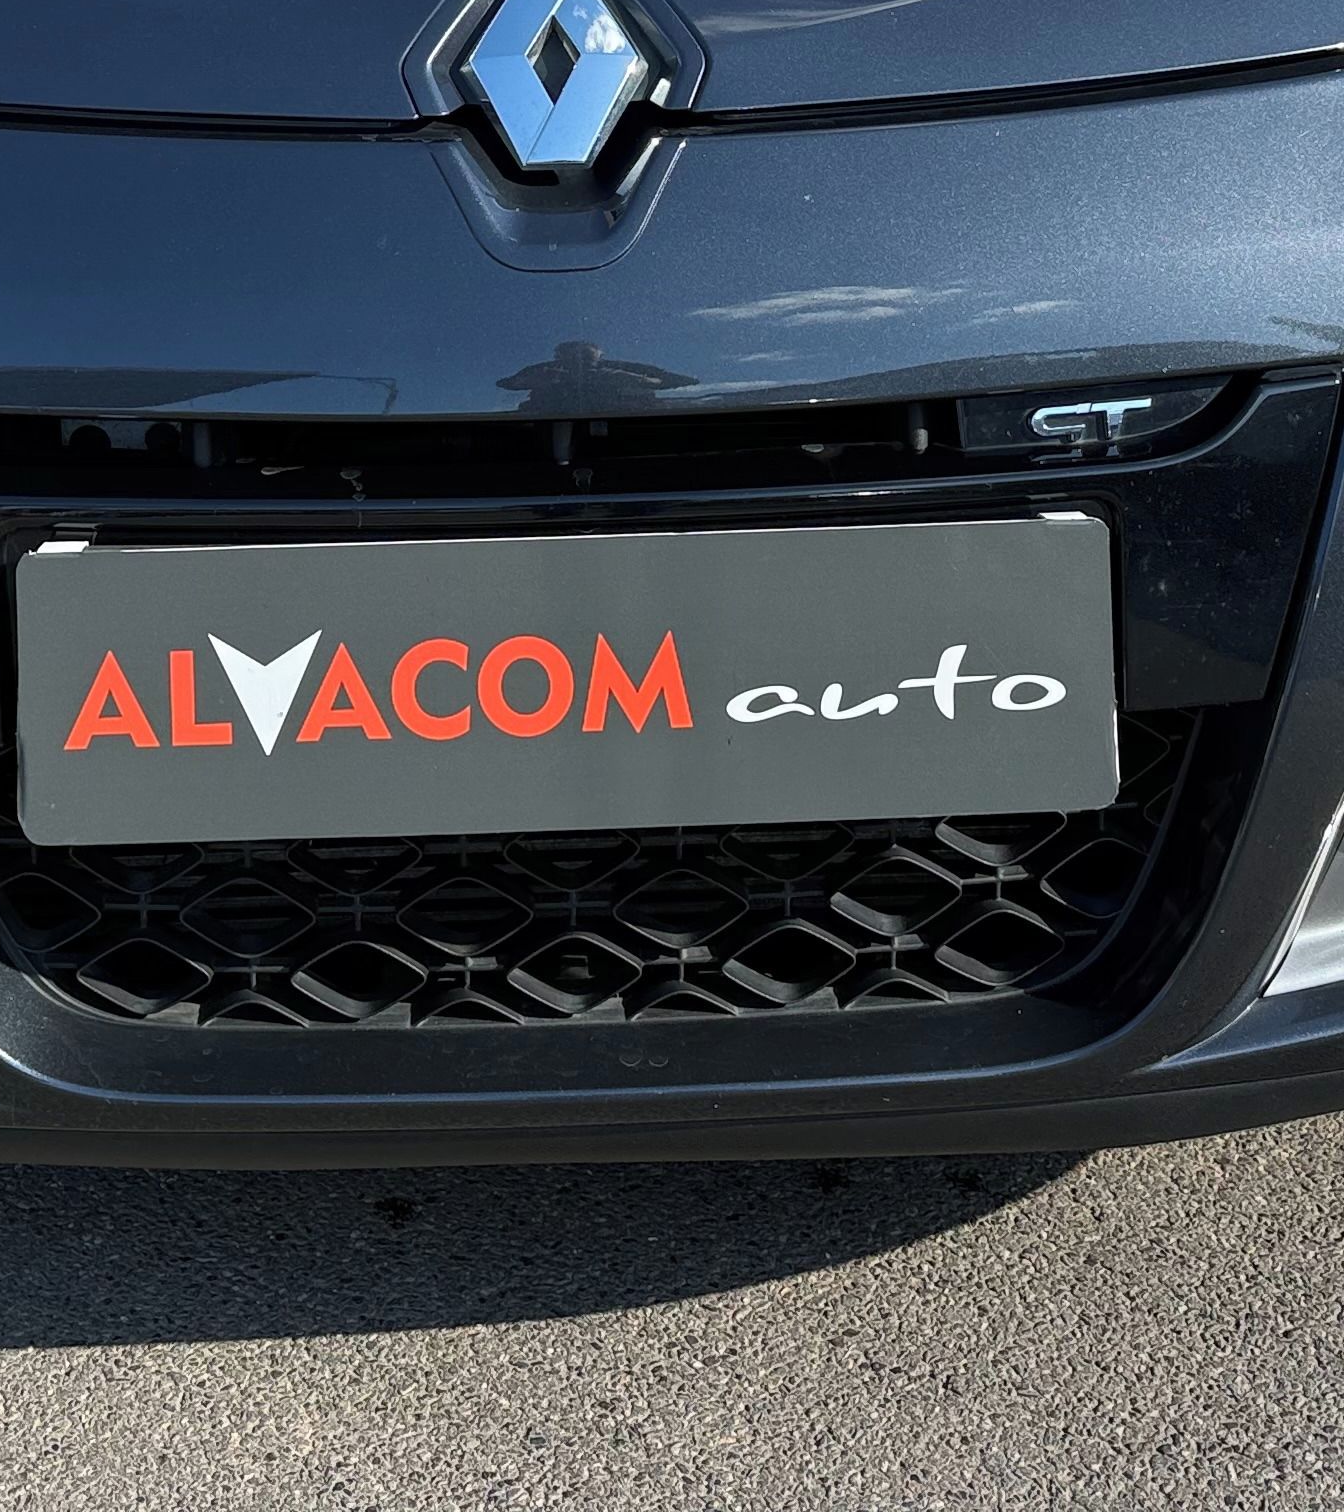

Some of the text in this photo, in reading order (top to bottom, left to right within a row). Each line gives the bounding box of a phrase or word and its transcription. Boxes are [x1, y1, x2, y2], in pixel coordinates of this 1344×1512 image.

[1031, 398, 1153, 440] GT
[63, 628, 1067, 756] ALVACOM auto
